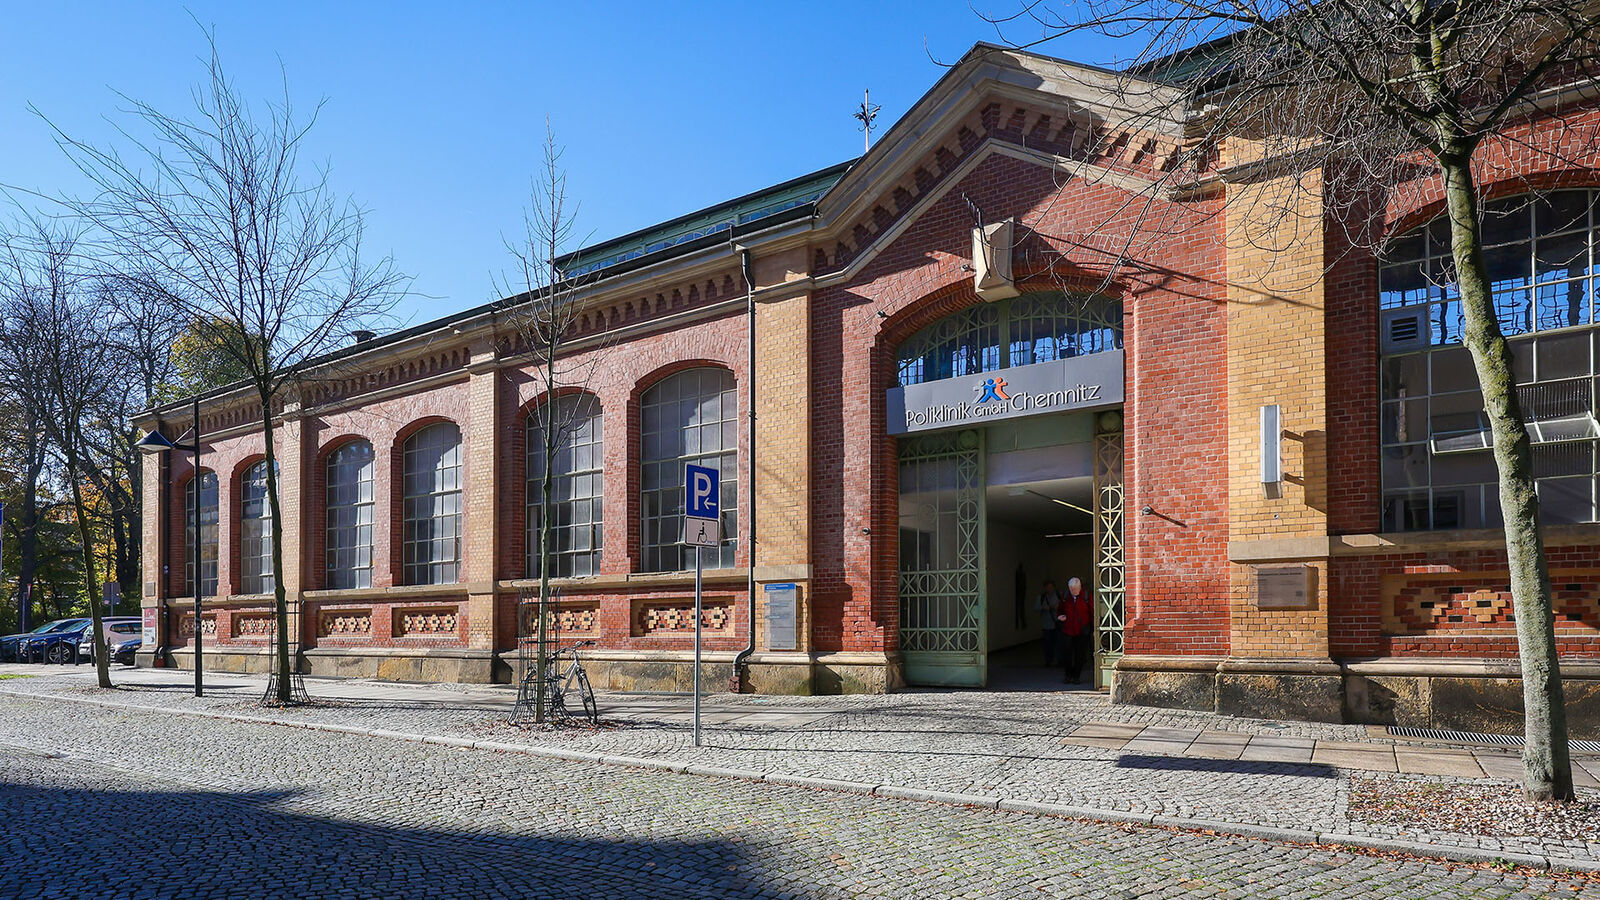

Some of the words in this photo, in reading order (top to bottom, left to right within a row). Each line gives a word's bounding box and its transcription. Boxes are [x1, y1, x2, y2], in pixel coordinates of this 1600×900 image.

[906, 401, 972, 427] Poliklinik
[974, 401, 1009, 418] GmbH
[1010, 383, 1101, 412] Chemnitz
[694, 471, 712, 511] P
